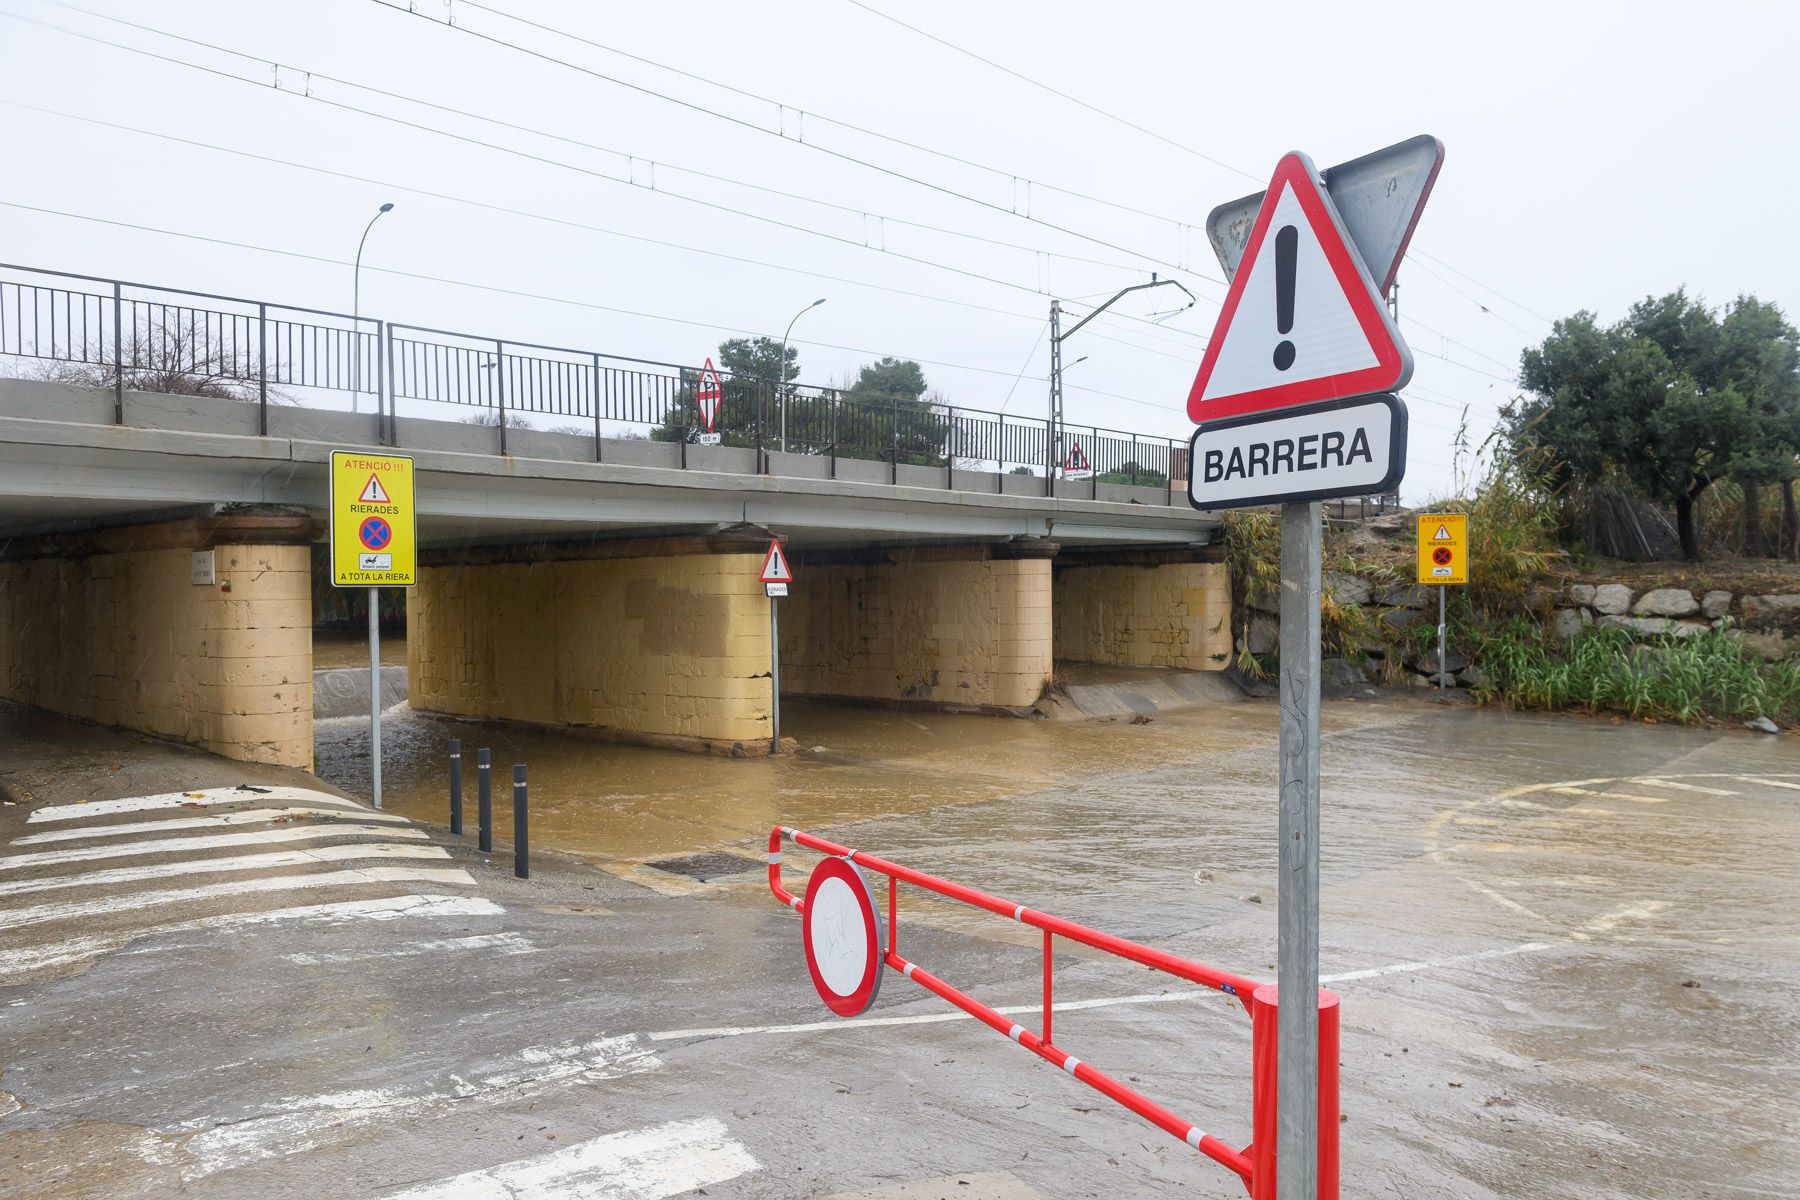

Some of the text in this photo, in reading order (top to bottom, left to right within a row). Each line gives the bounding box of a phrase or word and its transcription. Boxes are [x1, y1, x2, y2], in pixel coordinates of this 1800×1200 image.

[1204, 427, 1373, 483] BARRERA
[344, 459, 391, 472] ATENCIÓ
[350, 504, 399, 515] RIERADES
[340, 572, 410, 581] A TOTA LA RIERA
